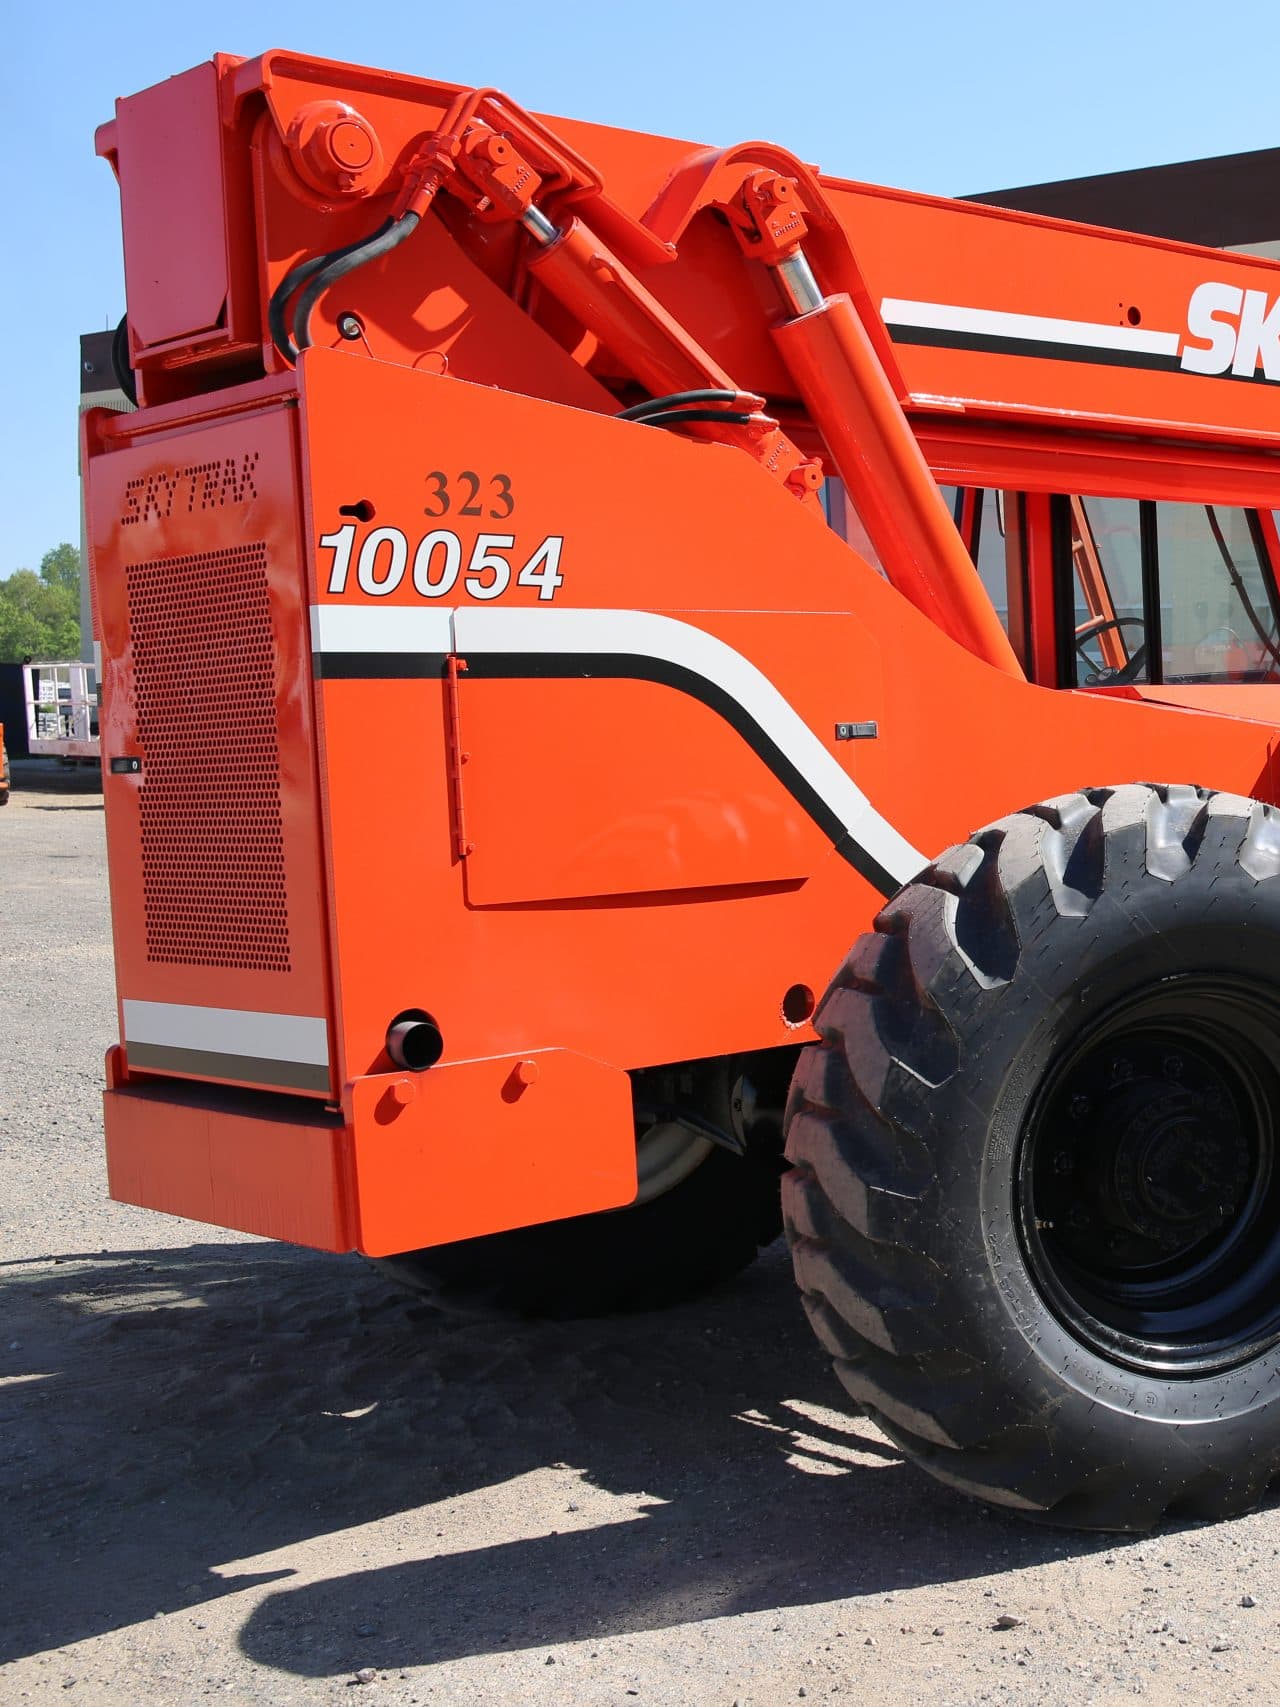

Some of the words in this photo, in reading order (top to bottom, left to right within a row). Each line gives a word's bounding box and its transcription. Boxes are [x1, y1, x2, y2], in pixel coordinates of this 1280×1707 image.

[121, 470, 181, 525] SKY
[184, 452, 259, 513] TRAK
[424, 471, 515, 519] 323
[319, 524, 564, 601] 10054
